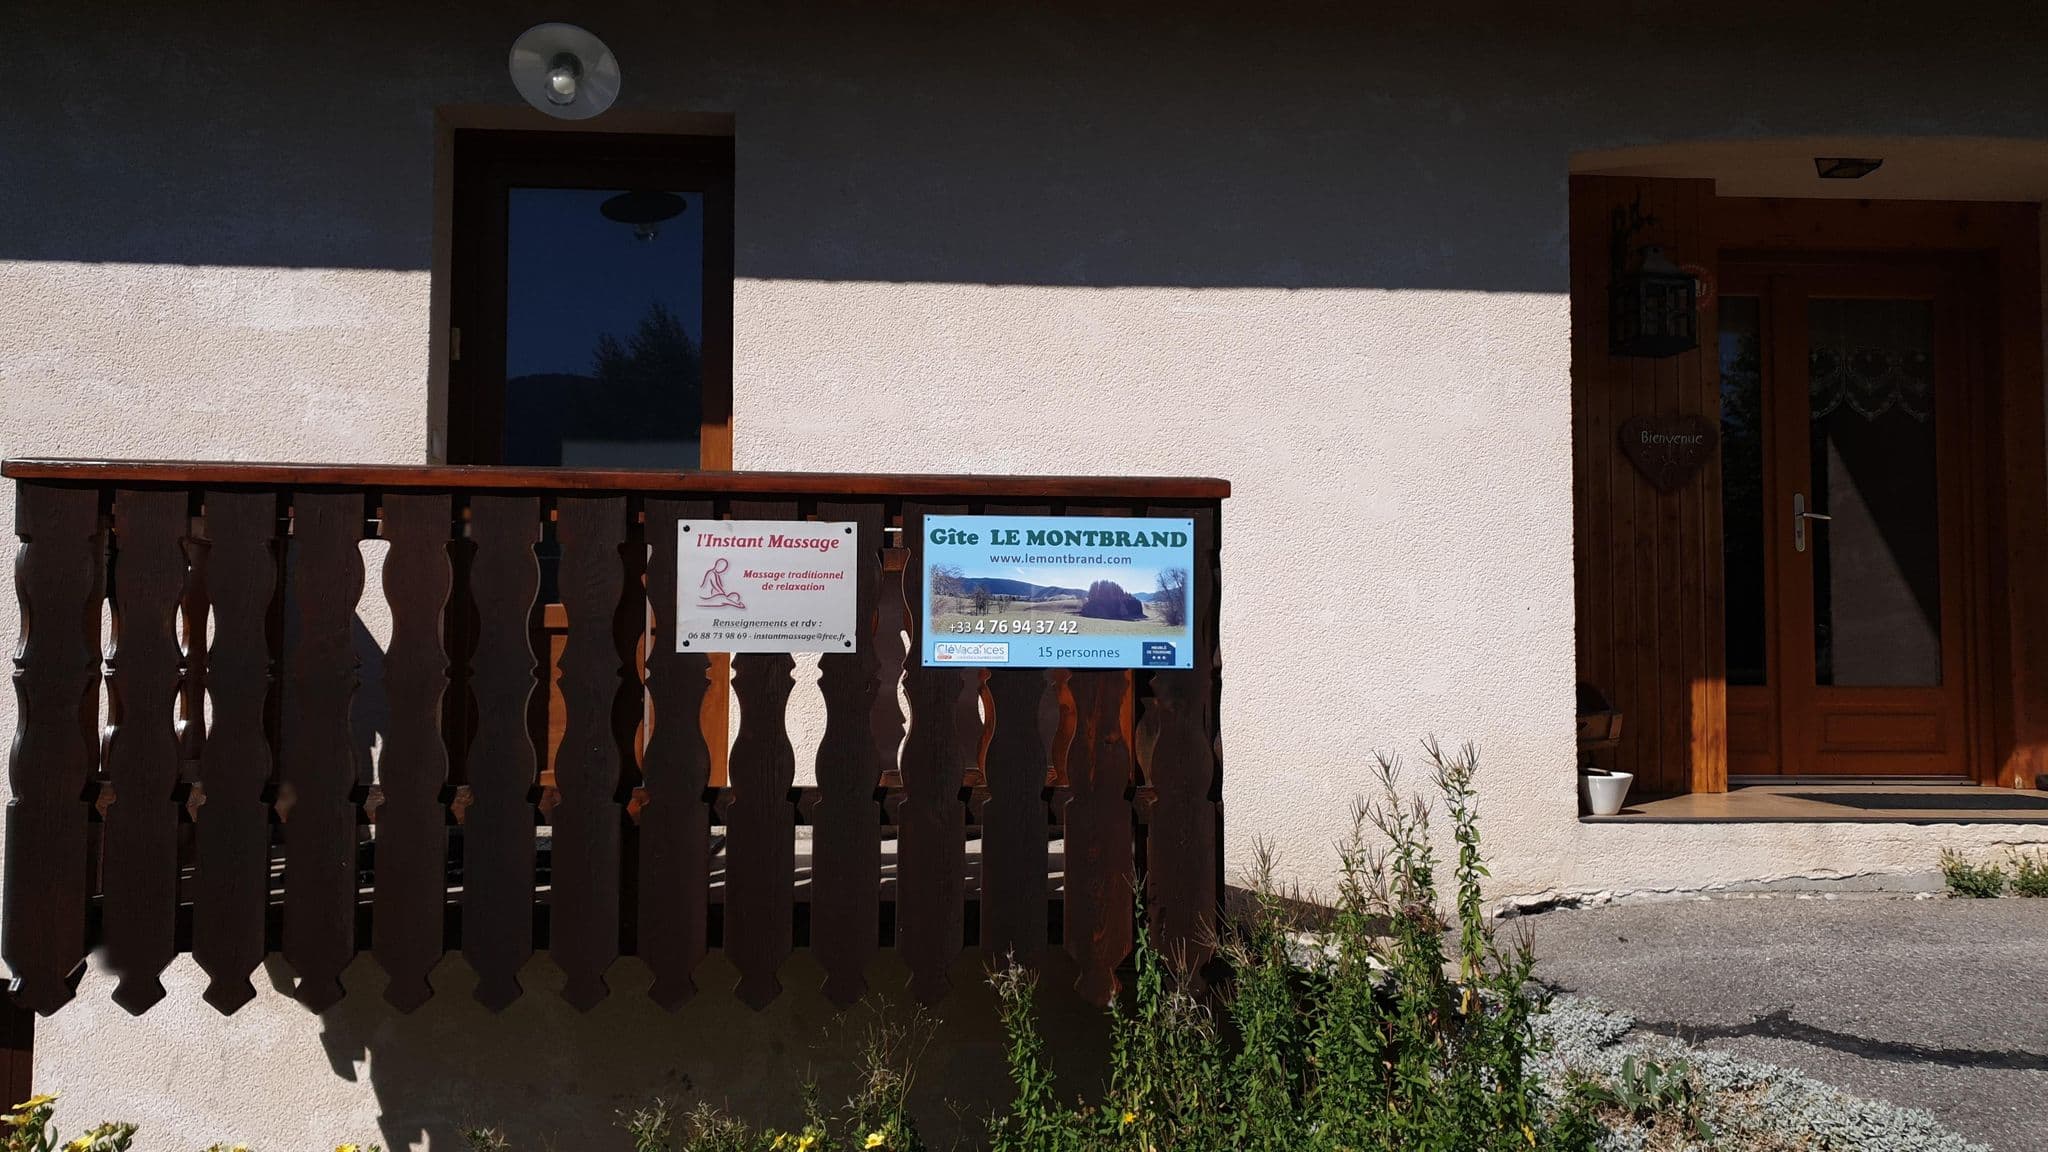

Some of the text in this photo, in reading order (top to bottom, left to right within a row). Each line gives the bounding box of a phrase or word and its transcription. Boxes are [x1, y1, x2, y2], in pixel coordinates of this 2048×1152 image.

[1641, 430, 1704, 444] Bienvenue
[696, 533, 840, 552] l'Instant Massage
[930, 528, 1187, 548] Gîte LE MONTBRAND
[990, 552, 1132, 565] www.lemontbrand.com
[743, 570, 844, 581] Massage traditionnel
[761, 582, 825, 591] de relaxation
[712, 618, 788, 630] Renseignements
[790, 620, 799, 628] et
[801, 619, 817, 628] rdv
[949, 620, 1078, 634] +33 4 76 94 37 42
[688, 632, 699, 640] 06
[700, 632, 711, 640] 88
[712, 632, 723, 640] 73
[725, 632, 736, 640] 98
[737, 632, 748, 640] 69
[753, 632, 846, 642] instantmassage@free.fr
[1038, 646, 1120, 660] 15 personnes
